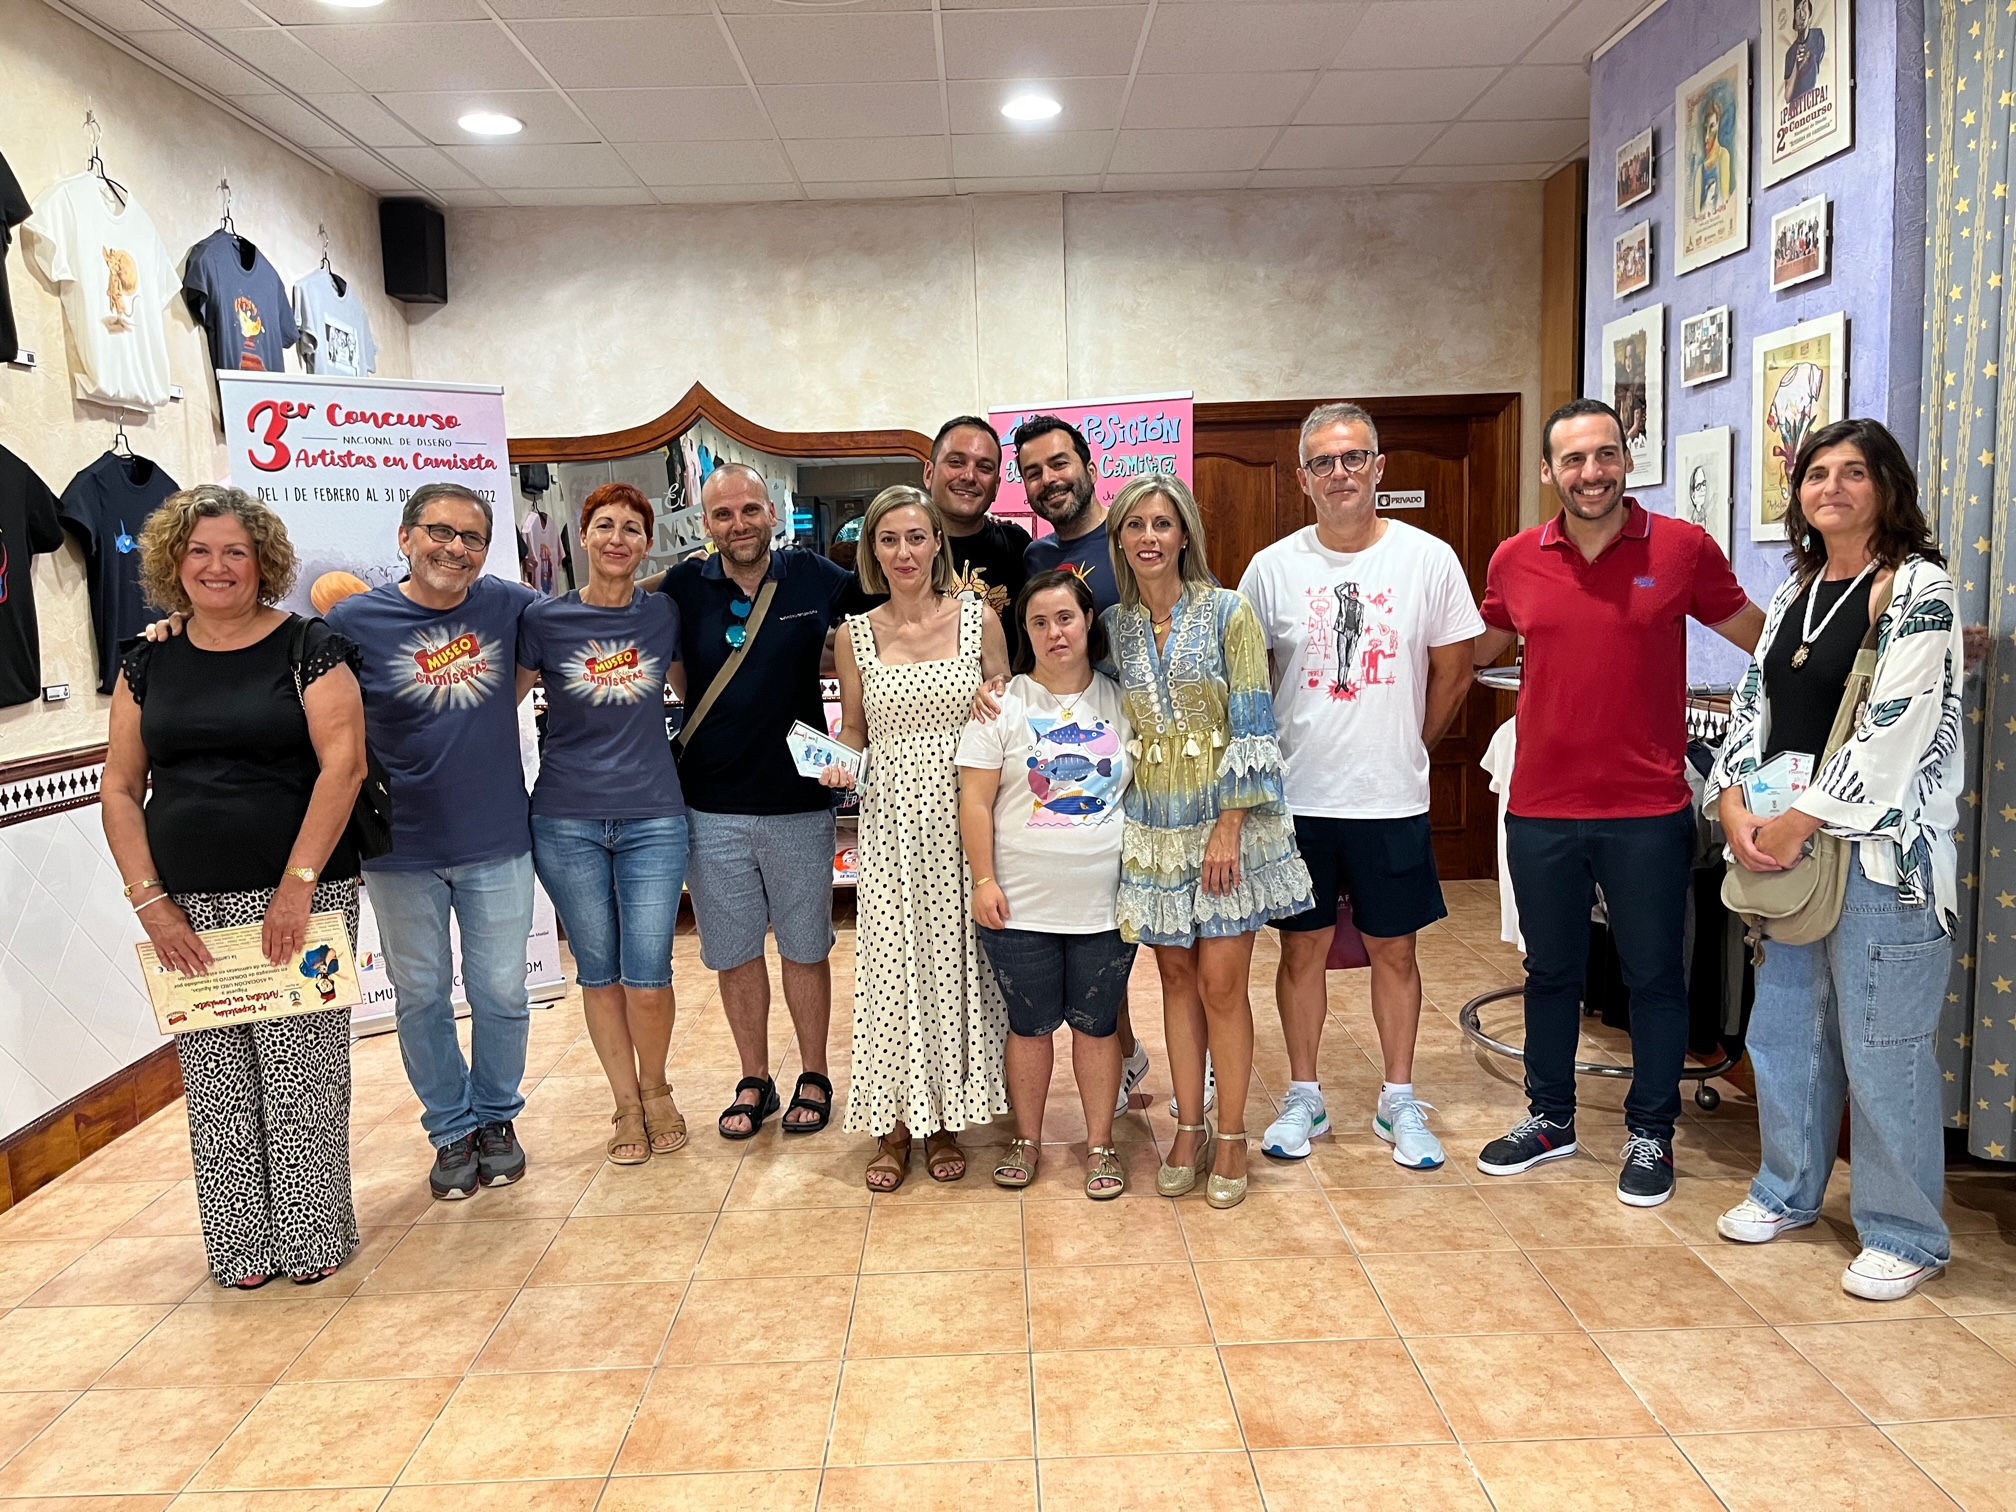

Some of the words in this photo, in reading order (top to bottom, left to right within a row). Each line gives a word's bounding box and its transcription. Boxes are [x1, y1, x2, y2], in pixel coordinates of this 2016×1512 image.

[1780, 85, 1828, 126] ¡PARTICIPA!
[1789, 102, 1833, 132] Concurso
[326, 403, 462, 431] Concurso
[342, 435, 394, 446] NACIONAL
[399, 437, 412, 446] DE
[416, 437, 453, 448] DISEÑO
[295, 449, 378, 469] Artistas
[383, 457, 408, 470] en
[412, 452, 498, 471] Camiseta
[257, 487, 278, 502] DEL
[284, 487, 289, 502] 1
[294, 487, 308, 502] DE
[314, 487, 360, 502] FEBRERO
[366, 488, 379, 502] AL
[385, 488, 395, 502] 31
[663, 482, 687, 509] El
[1391, 496, 1422, 504] PRIVADO
[426, 638, 472, 672] MUSEO
[594, 651, 633, 673] MUSEO
[219, 973, 248, 982] DONATIVO
[234, 978, 267, 987] ASOCIACIÓN
[213, 1004, 256, 1018] Exposición
